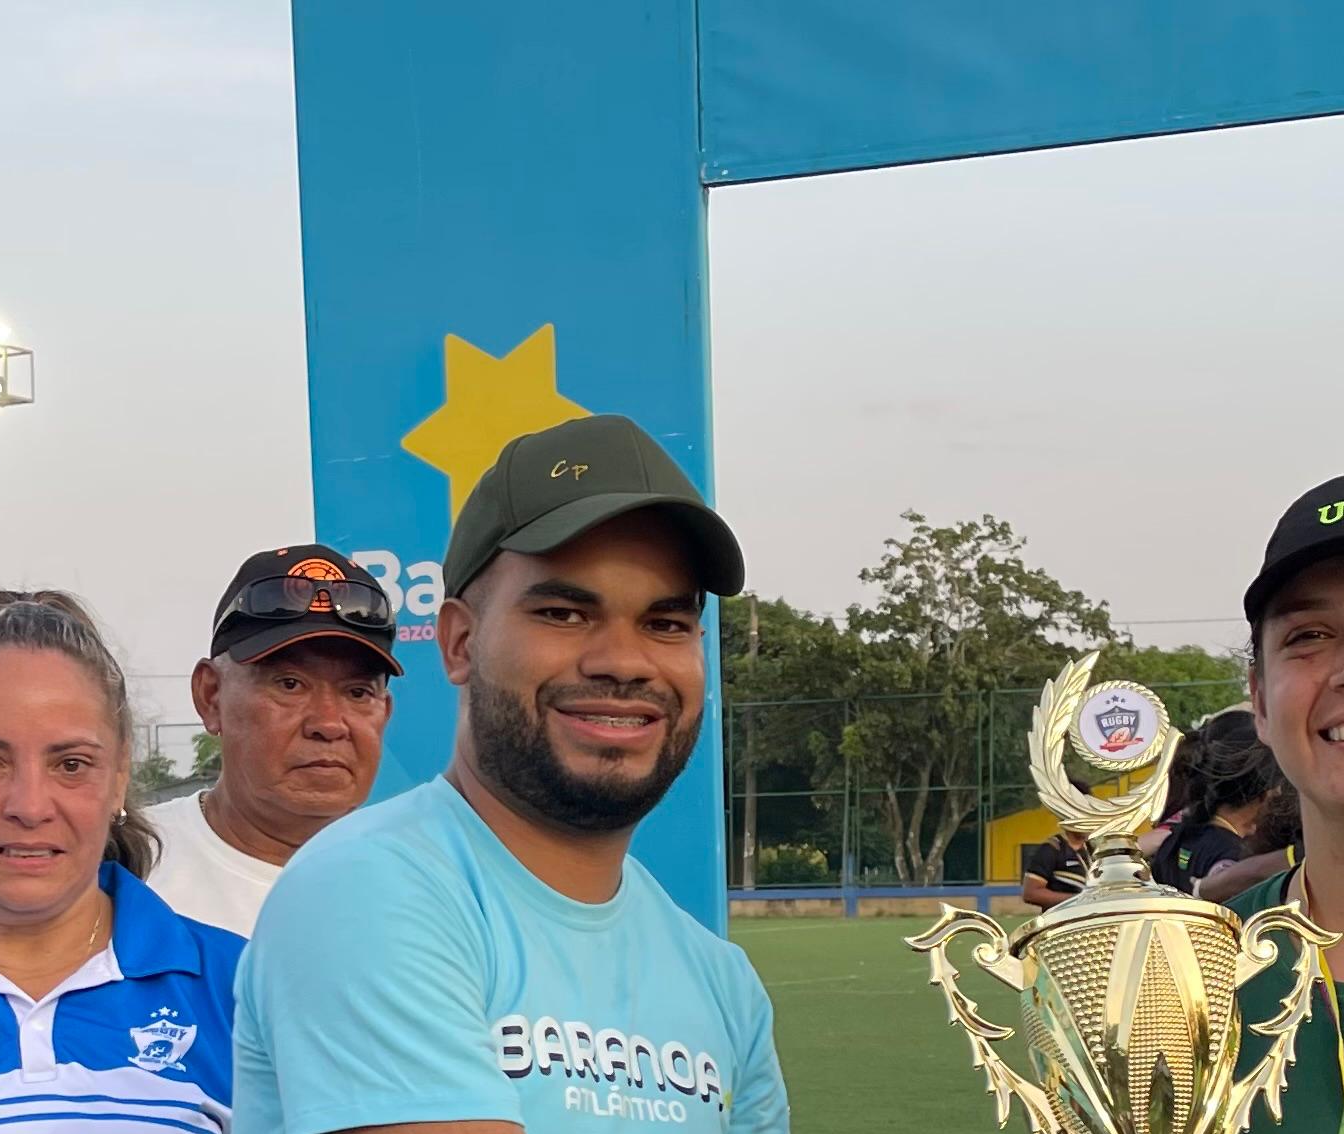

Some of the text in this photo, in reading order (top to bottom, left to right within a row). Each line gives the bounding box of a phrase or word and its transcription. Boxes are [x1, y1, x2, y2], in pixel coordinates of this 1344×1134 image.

[1100, 715, 1136, 728] RUGBY
[492, 1013, 725, 1112] BARANOA
[564, 1084, 687, 1124] ATLÁNTICO
